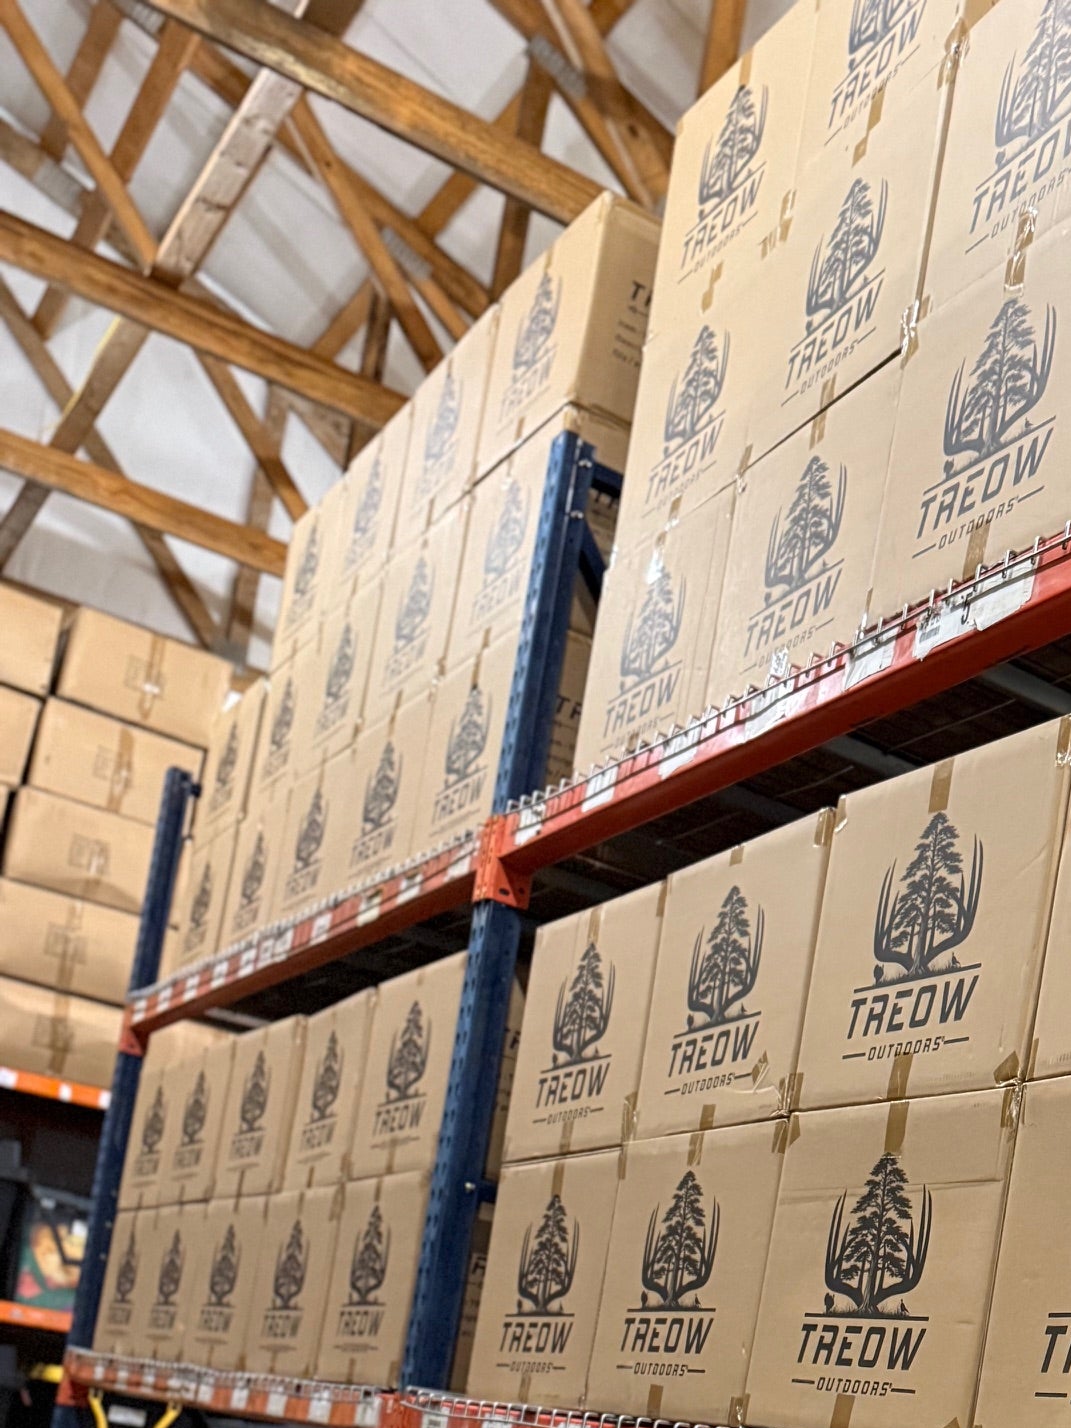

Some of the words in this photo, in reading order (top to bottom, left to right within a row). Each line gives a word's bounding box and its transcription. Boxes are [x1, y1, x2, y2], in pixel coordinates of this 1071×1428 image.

[786, 278, 883, 389] TREOW
[916, 428, 1053, 539] TREOW
[743, 568, 841, 657] TREOW
[847, 975, 979, 1039] TREOW
[668, 1021, 759, 1077] TREOW
[868, 1035, 942, 1061] OUTDOORS
[536, 1063, 610, 1109] TREOW
[500, 1322, 573, 1354] TREOW
[620, 1317, 714, 1354] TREOW
[797, 1323, 926, 1370] TREOW
[634, 1361, 687, 1377] OUTDOORS
[816, 1377, 890, 1396] OUTDOORS
